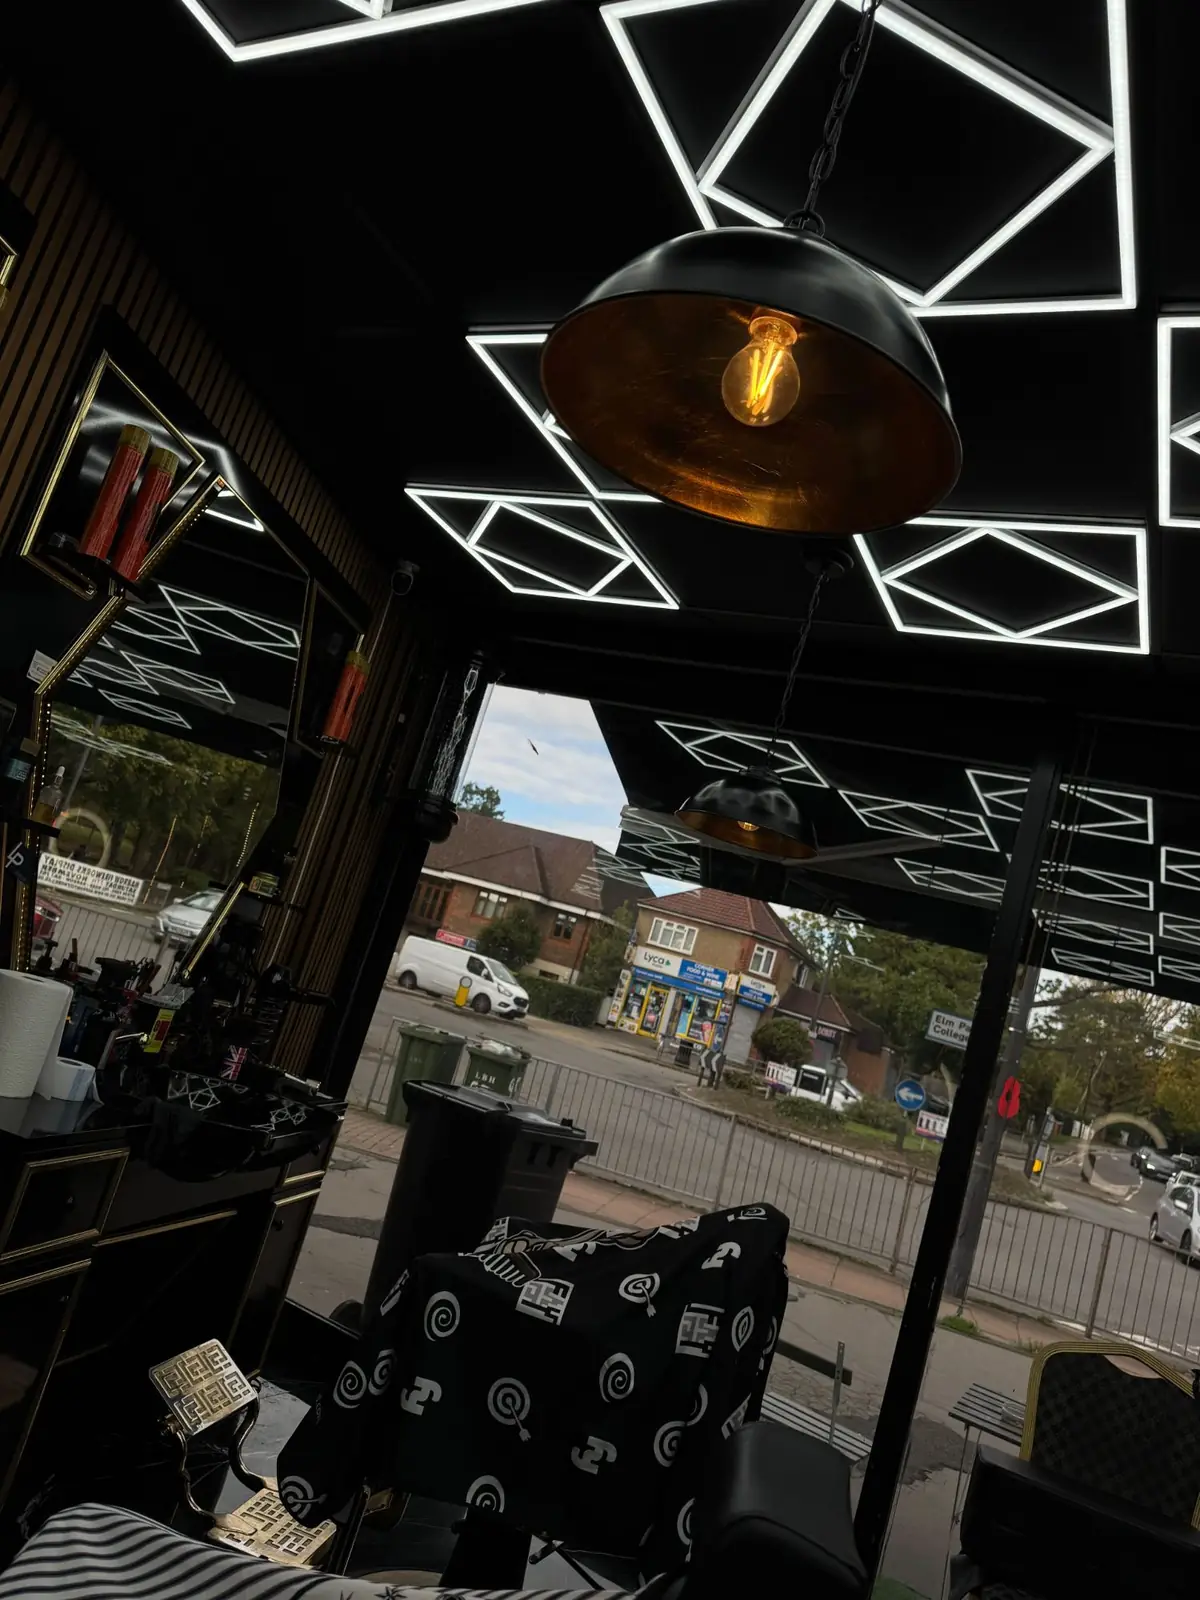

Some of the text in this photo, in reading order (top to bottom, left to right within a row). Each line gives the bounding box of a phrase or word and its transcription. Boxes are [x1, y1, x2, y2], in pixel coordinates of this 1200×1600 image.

[644, 951, 665, 965] Lyca
[686, 966, 701, 975] FOOD
[706, 972, 720, 981] WINE
[935, 1014, 971, 1033] Elm Pa
[474, 1071, 496, 1085] LBH
